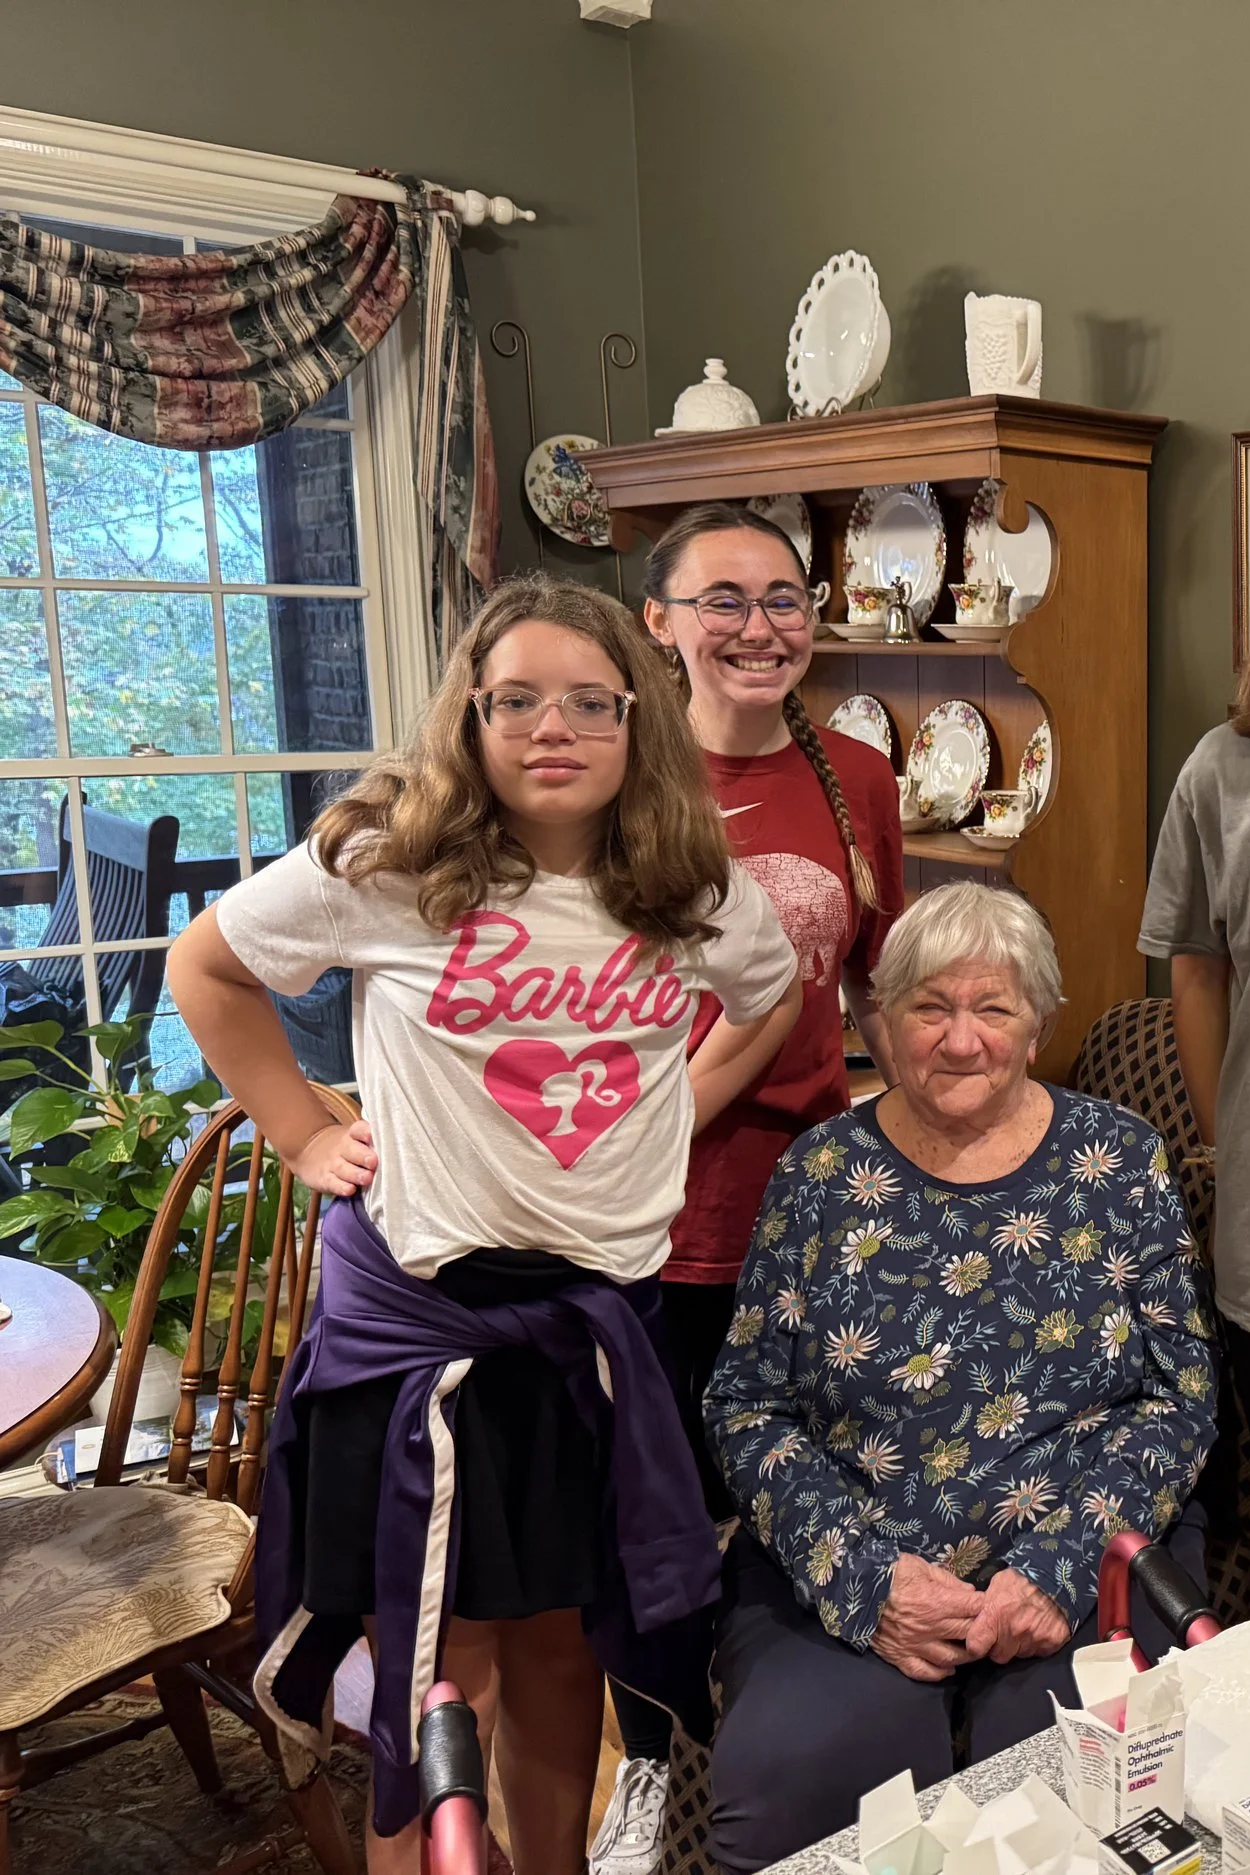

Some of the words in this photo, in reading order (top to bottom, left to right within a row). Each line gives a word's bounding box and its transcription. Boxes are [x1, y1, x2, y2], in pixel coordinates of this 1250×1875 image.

[426, 910, 691, 1035] Barbie
[1128, 1729, 1183, 1754] Difluprednate
[1127, 1744, 1174, 1767] Ophthalmic
[1128, 1761, 1162, 1779] Emulsion
[1129, 1775, 1156, 1791] 0.05%
